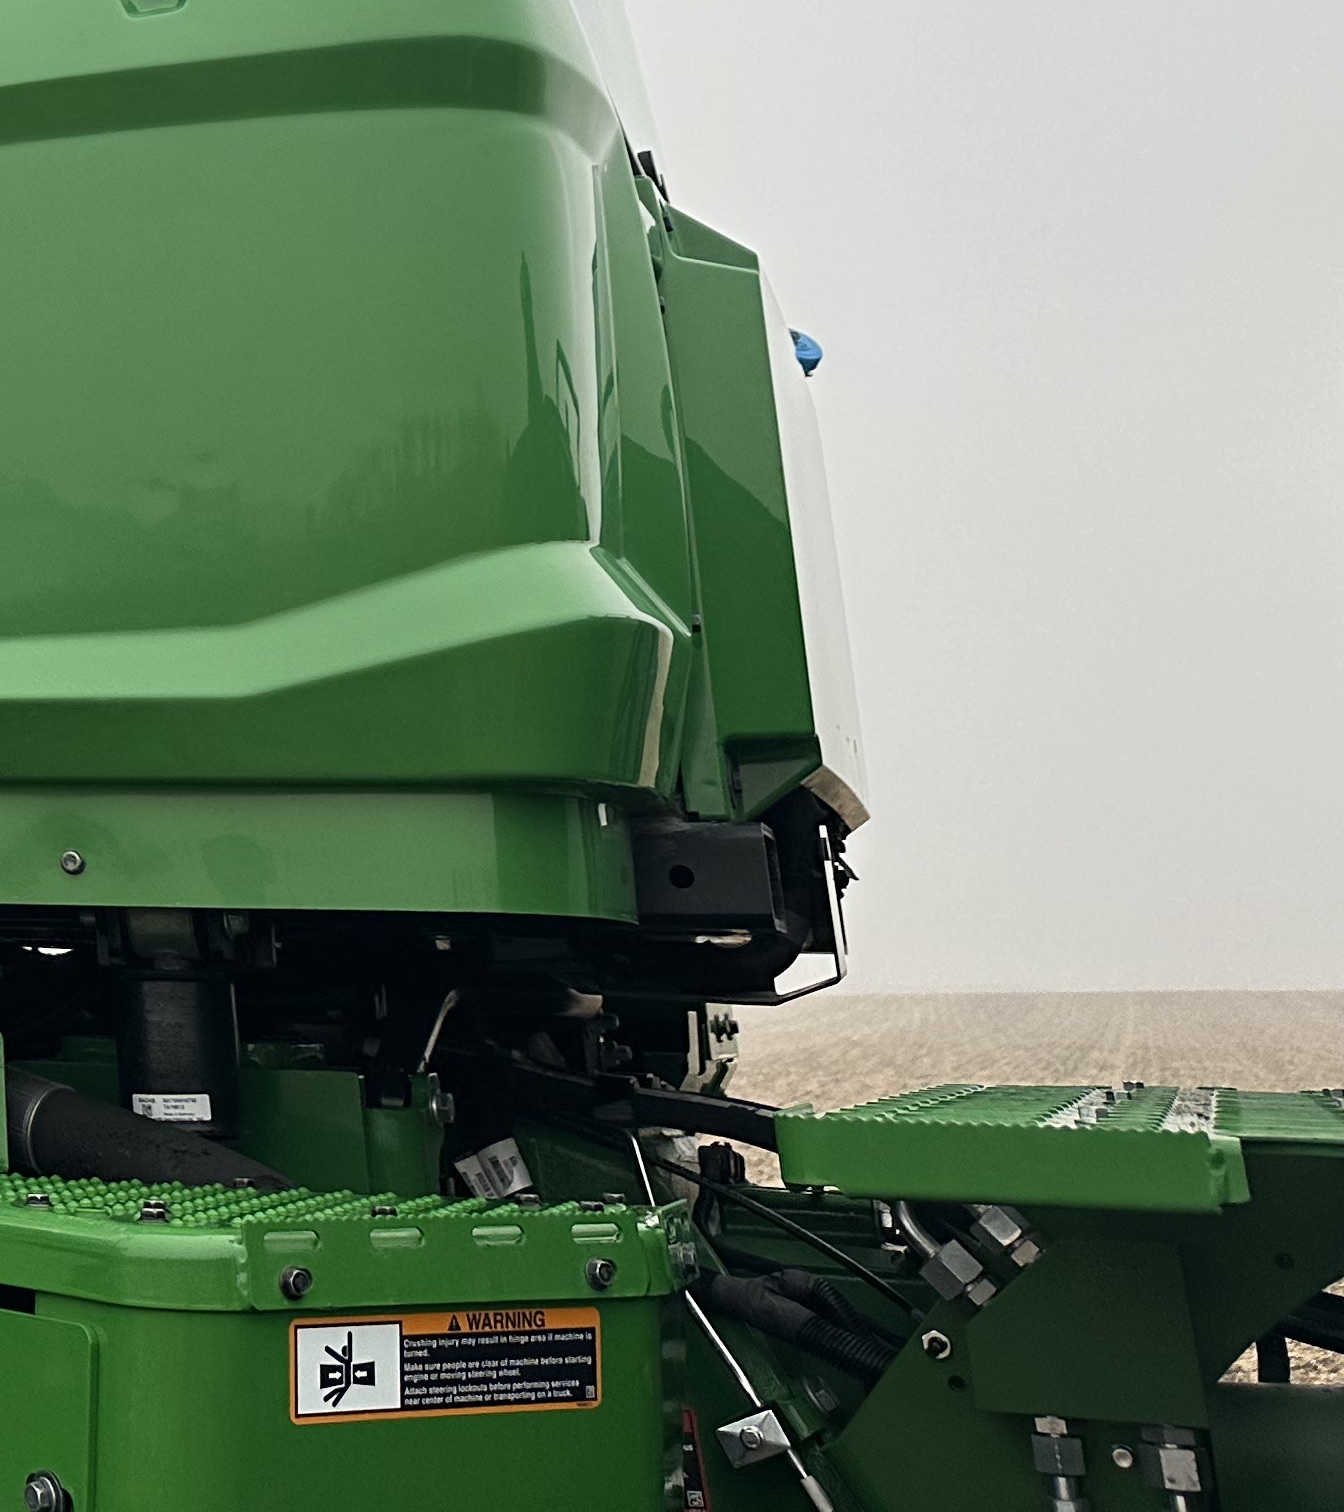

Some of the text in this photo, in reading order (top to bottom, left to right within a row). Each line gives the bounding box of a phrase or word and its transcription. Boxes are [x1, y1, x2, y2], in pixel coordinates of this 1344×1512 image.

[466, 1311, 545, 1330] WARNING
[404, 1338, 437, 1348] Crushing
[439, 1337, 459, 1347] injury
[461, 1338, 476, 1346] may
[478, 1336, 498, 1344] result
[554, 1332, 584, 1340] machine
[585, 1332, 592, 1340] is
[404, 1363, 423, 1371] Make
[442, 1360, 466, 1371] people
[481, 1359, 498, 1367] clear
[500, 1358, 508, 1366] of
[509, 1357, 538, 1366] machine
[540, 1356, 563, 1365] before
[565, 1355, 592, 1364] starting
[404, 1373, 428, 1383] engine
[440, 1371, 466, 1380] moving
[468, 1369, 496, 1379] steering
[404, 1387, 427, 1395] Attach
[429, 1385, 457, 1394] steering
[489, 1382, 511, 1391] before
[513, 1380, 549, 1391] performing
[551, 1379, 579, 1387] services
[422, 1396, 443, 1405] center
[445, 1395, 452, 1403] of
[454, 1394, 483, 1402] machine
